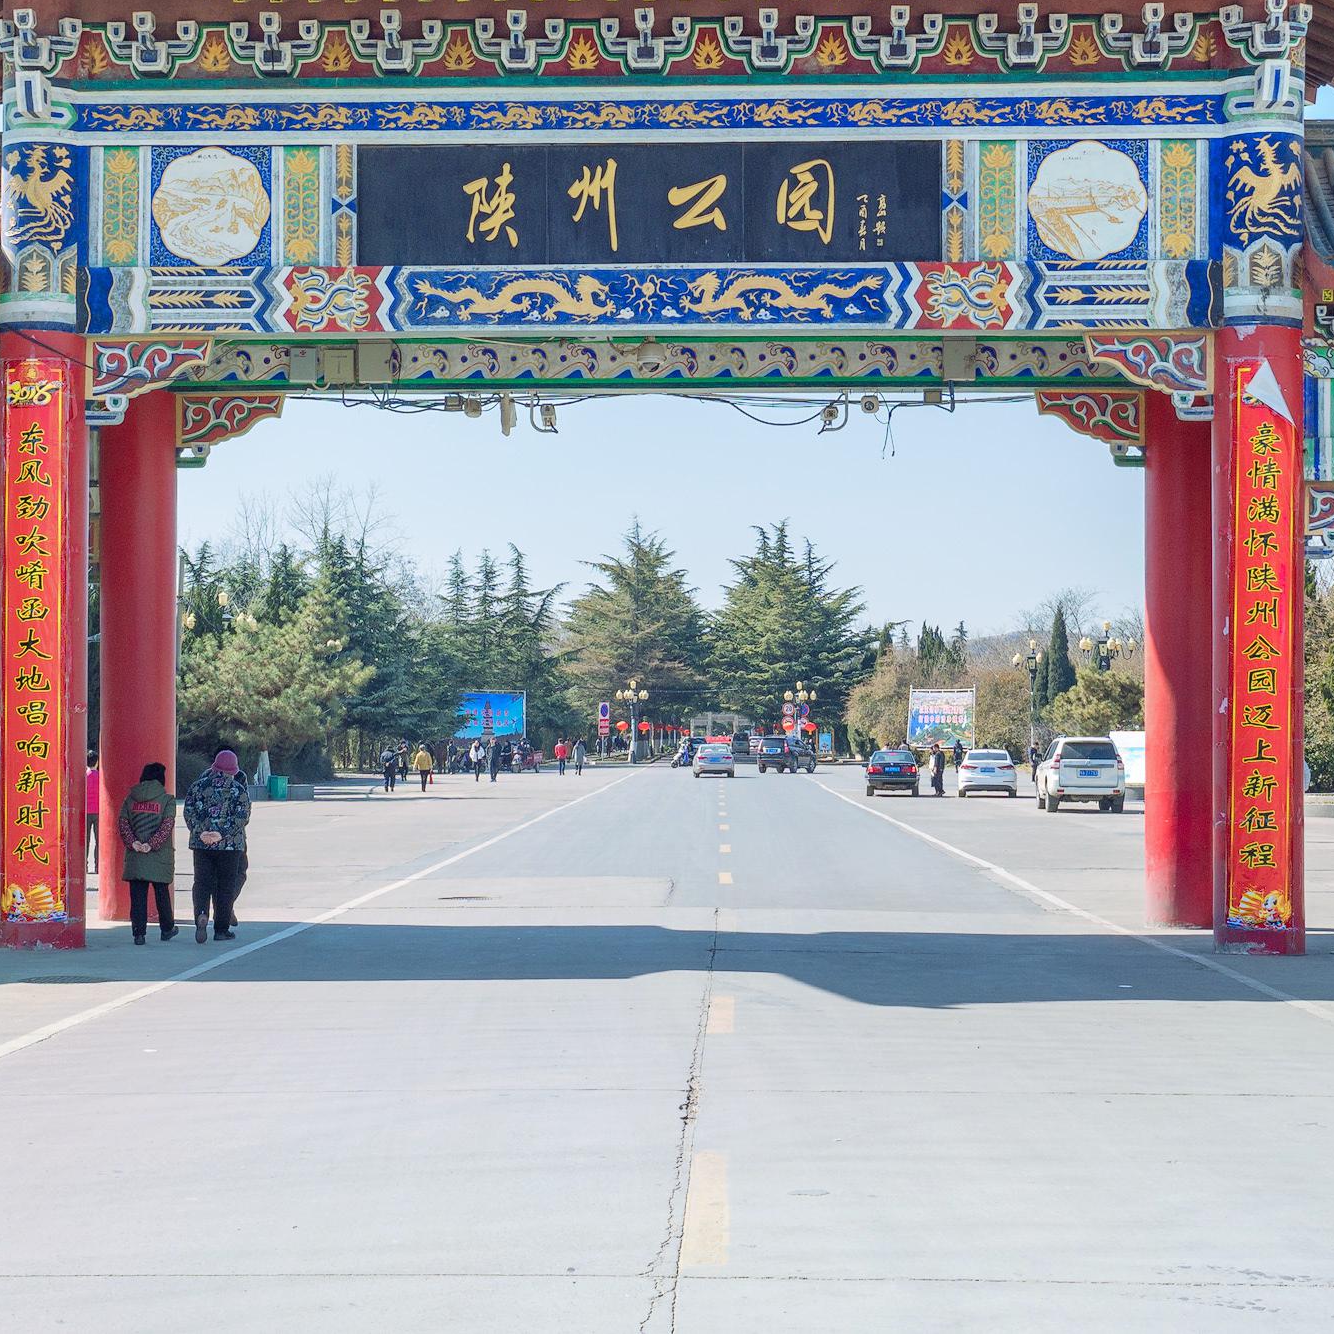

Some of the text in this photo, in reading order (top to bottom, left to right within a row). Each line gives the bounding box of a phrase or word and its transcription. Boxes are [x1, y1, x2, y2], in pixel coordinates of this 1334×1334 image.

[13, 422, 53, 866] 东风劲吹崤函大地唱响新时代
[1239, 423, 1281, 868] 豪情满怀陕州公园迈上新征程
